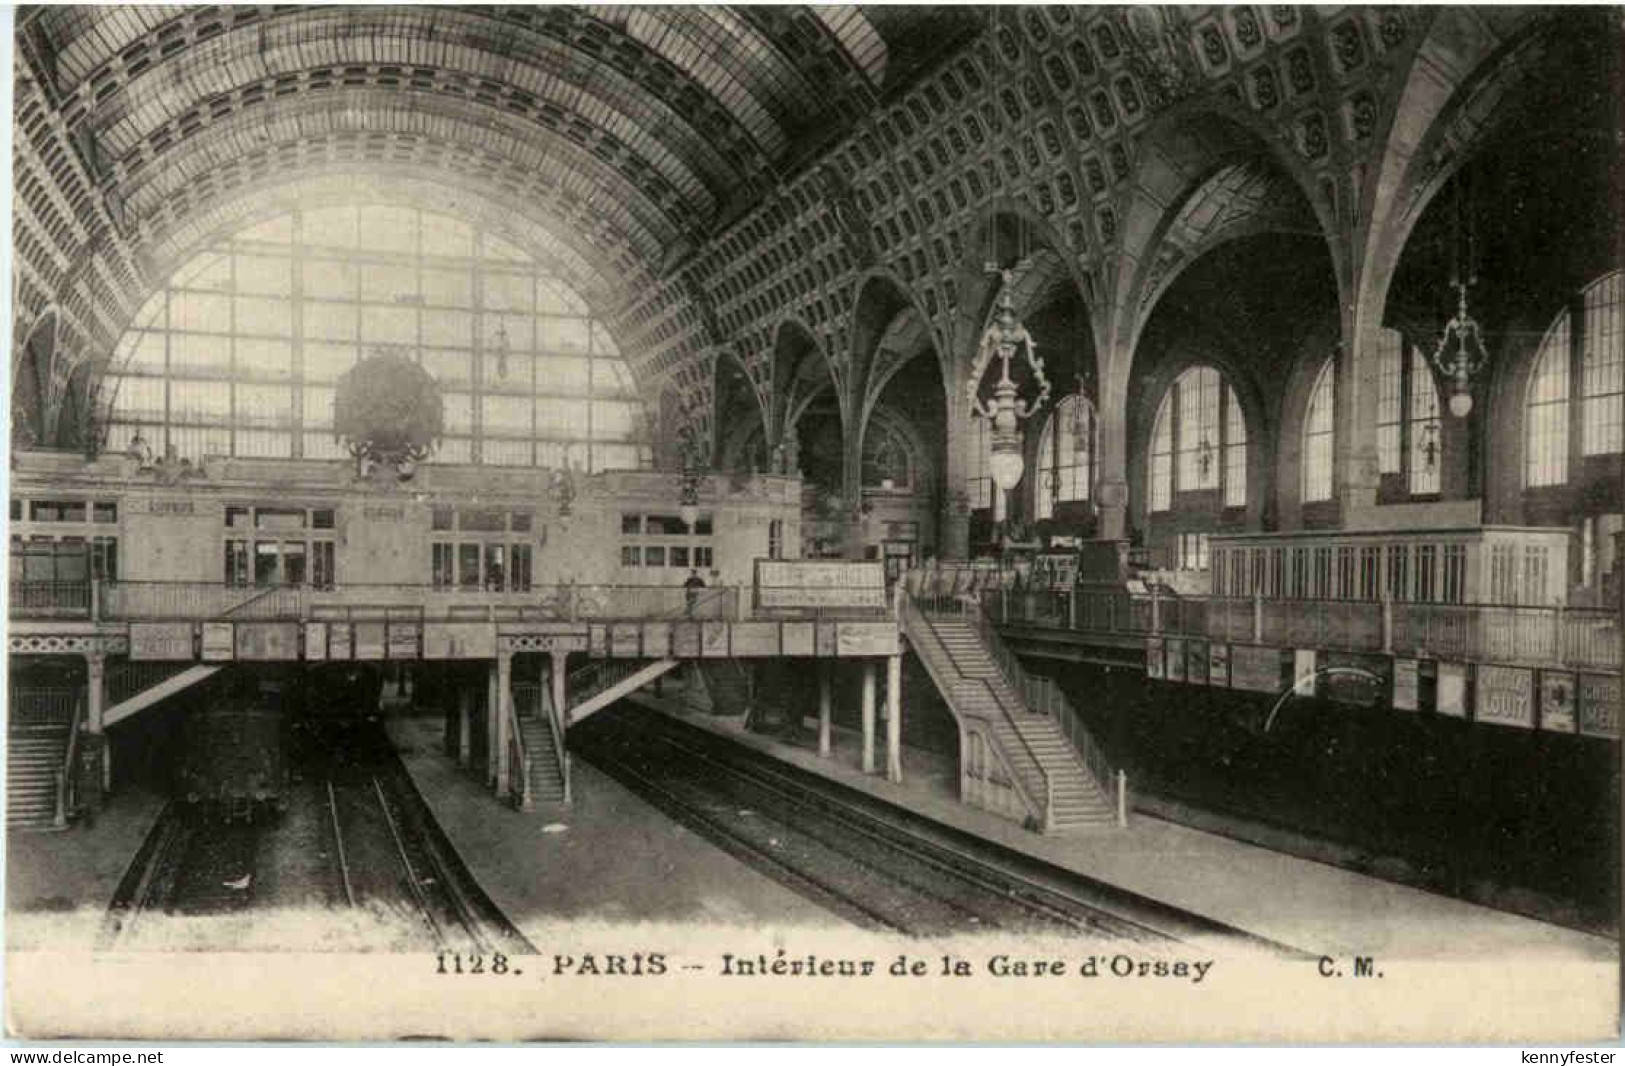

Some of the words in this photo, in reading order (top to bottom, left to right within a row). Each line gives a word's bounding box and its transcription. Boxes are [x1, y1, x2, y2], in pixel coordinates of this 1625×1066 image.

[436, 954, 522, 975] 1128.
[553, 954, 668, 976] PARIS
[721, 950, 874, 976] Intérieur
[889, 955, 927, 977] de
[942, 955, 972, 977] la
[987, 955, 1066, 977] Gare
[1079, 955, 1213, 982] d'Orsay
[1317, 956, 1342, 977] C.
[1354, 956, 1384, 977] M.
